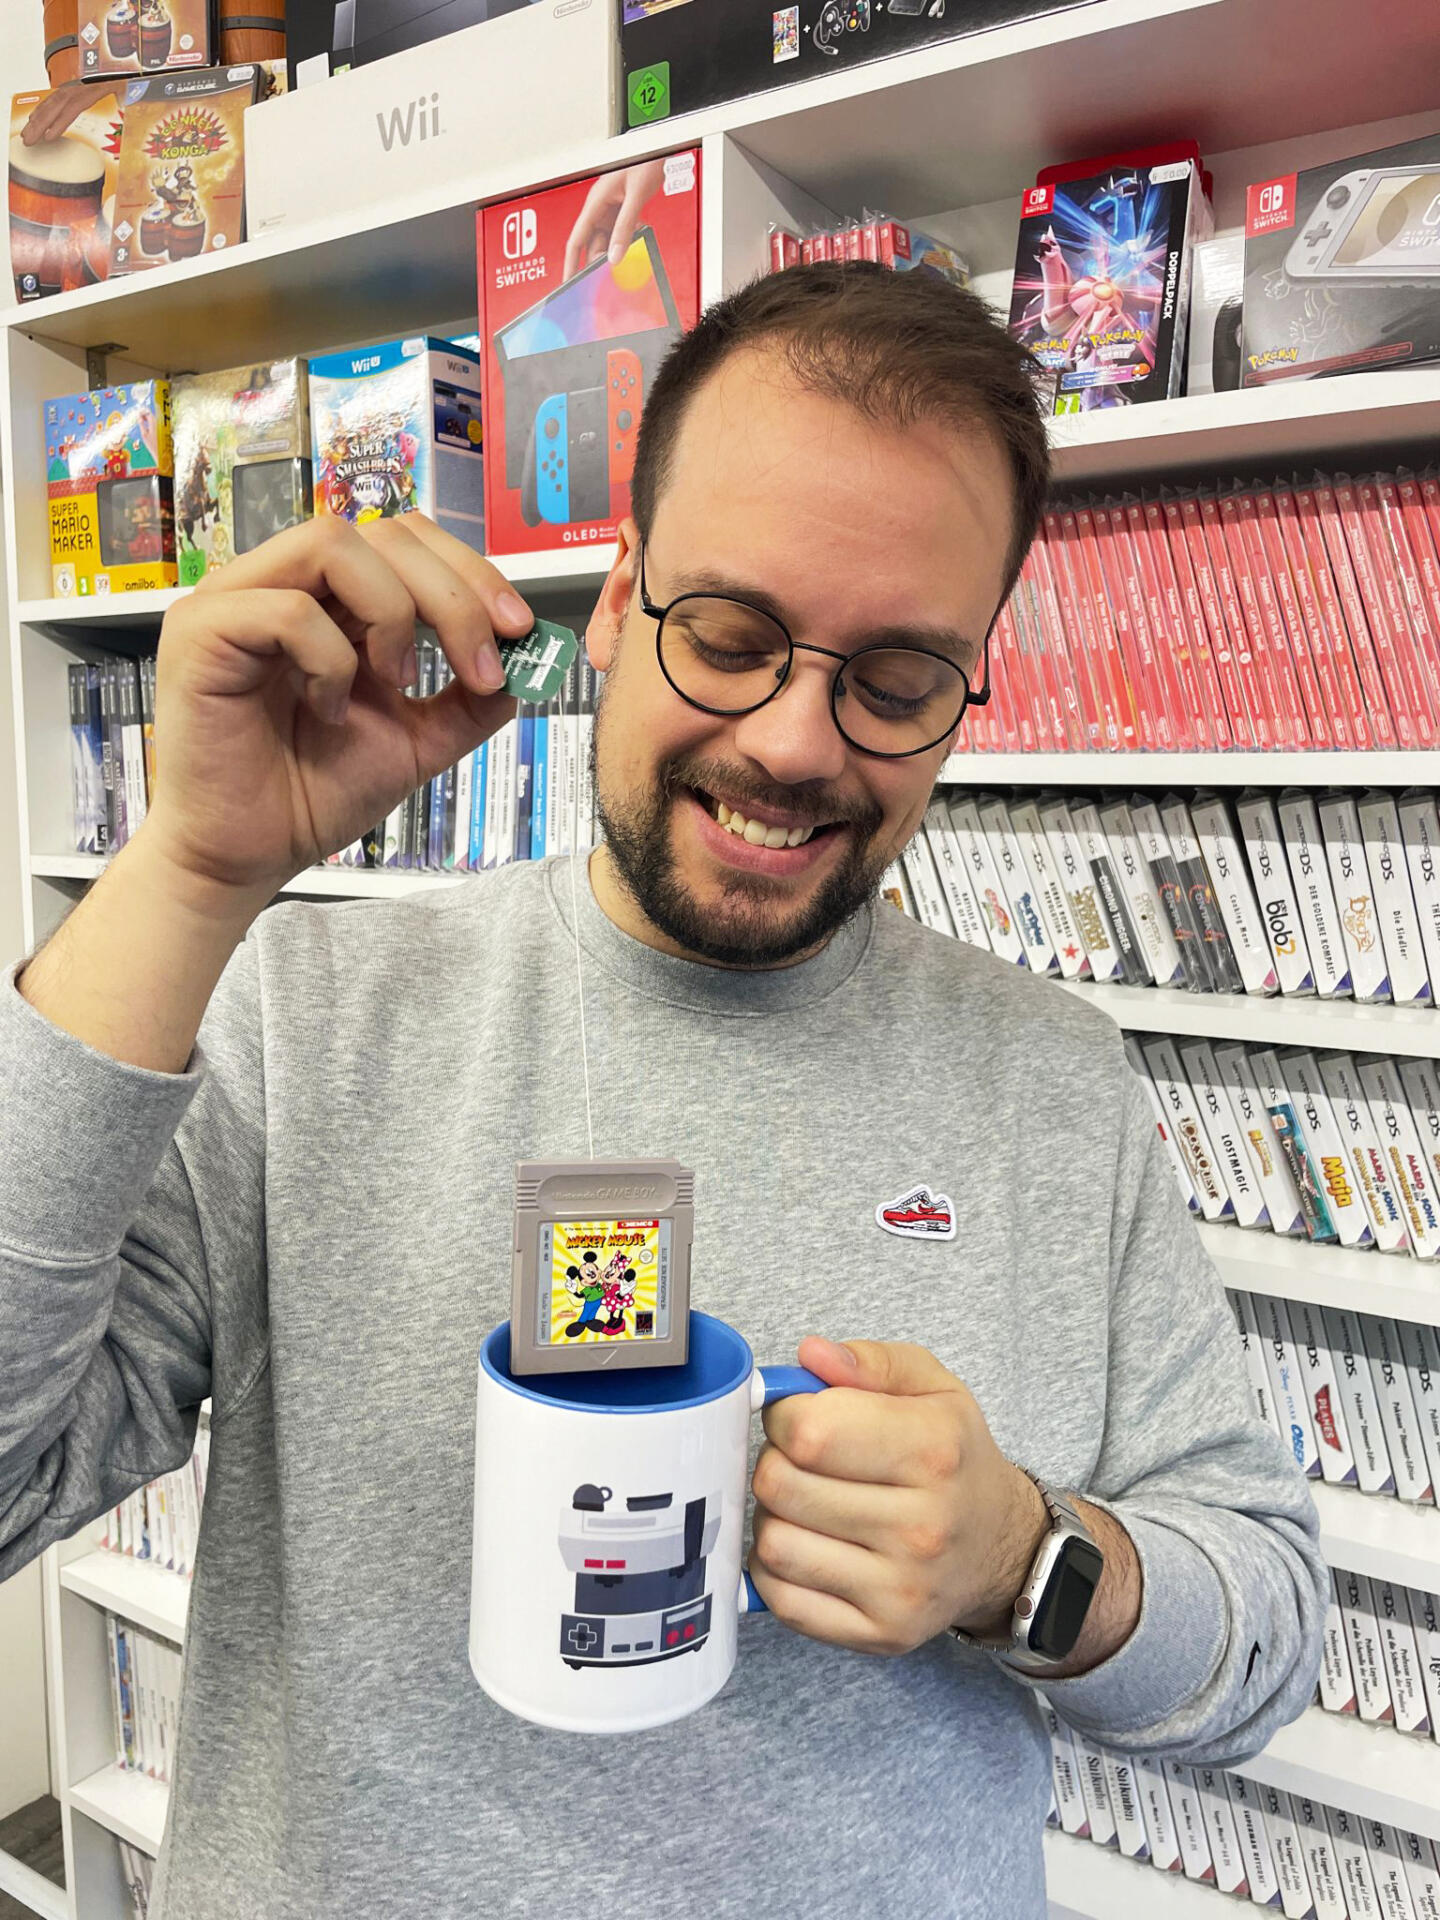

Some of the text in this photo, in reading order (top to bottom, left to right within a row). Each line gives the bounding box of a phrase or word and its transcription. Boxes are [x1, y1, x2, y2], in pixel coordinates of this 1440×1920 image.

[640, 86, 656, 106] 12
[376, 92, 440, 151] Wii
[160, 145, 209, 160] KONGA
[1254, 216, 1288, 230] SWITCH
[496, 257, 544, 274] NINTENDO
[496, 266, 544, 289] SWITCH
[1163, 251, 1179, 320] DOPPELPACK
[352, 360, 369, 374] Wii
[349, 441, 384, 458] SUPER
[354, 480, 371, 492] Wii
[51, 502, 78, 518] SUPER
[52, 515, 90, 535] MARIO
[563, 528, 598, 542] OLED
[53, 532, 93, 553] MAKER
[188, 566, 198, 577] 12
[124, 579, 156, 591] amiibo
[1216, 856, 1229, 878] DS
[1258, 855, 1272, 877] DS
[1299, 853, 1313, 876] DS
[1339, 856, 1354, 878] DS
[1380, 858, 1394, 880] DS
[1420, 859, 1434, 882] DS
[1098, 874, 1118, 912] CHRONO
[1229, 894, 1243, 924] Cooking
[1430, 903, 1440, 918] THE
[1308, 884, 1334, 975] DER GOLDENE KOMPASS
[1392, 910, 1408, 957] Die Siedler
[1168, 1089, 1183, 1110] DS
[1205, 1093, 1220, 1115] DS
[1239, 1098, 1254, 1120] DS
[1305, 1107, 1321, 1131] DS
[1346, 1109, 1361, 1132] DS
[1384, 1114, 1400, 1138] DS
[1427, 1113, 1440, 1138] DS
[1220, 1133, 1249, 1194] LOSTMAGIC
[1317, 1152, 1356, 1210] Maja
[1367, 1146, 1399, 1222] MARIO SONIC
[1406, 1152, 1437, 1229] MARIO SONIC
[566, 1234, 606, 1250] MICKEY
[607, 1232, 646, 1248] MOUSE
[1271, 1339, 1287, 1362] DS
[1306, 1344, 1321, 1368] DS
[1343, 1354, 1357, 1377] DS
[1381, 1362, 1396, 1385] DS
[1418, 1368, 1433, 1392] DS
[1253, 1387, 1271, 1421] Nintendogs
[1315, 1396, 1336, 1439] PLANES
[1347, 1585, 1361, 1607] DS
[1382, 1595, 1396, 1618] DS
[1350, 1618, 1358, 1629] und
[1385, 1628, 1393, 1639] und
[1333, 1657, 1344, 1677] Layton
[1363, 1637, 1380, 1687] Professor Layton
[1398, 1647, 1416, 1698] Professor Layton
[1085, 1754, 1109, 1811] Suikoden
[1113, 1764, 1138, 1822] Suikoden
[1152, 1806, 1160, 1822] Mario
[1184, 1814, 1193, 1830] Mario
[1216, 1826, 1225, 1842] Mario
[1243, 1809, 1257, 1849] SUPERMAN
[1283, 1835, 1292, 1846] The
[1318, 1846, 1326, 1855] The
[1285, 1846, 1296, 1867] Legend
[1319, 1856, 1330, 1877] Legend
[1353, 1855, 1365, 1887] The Legend
[1388, 1870, 1401, 1902] The Legend
[1425, 1883, 1433, 1893] The
